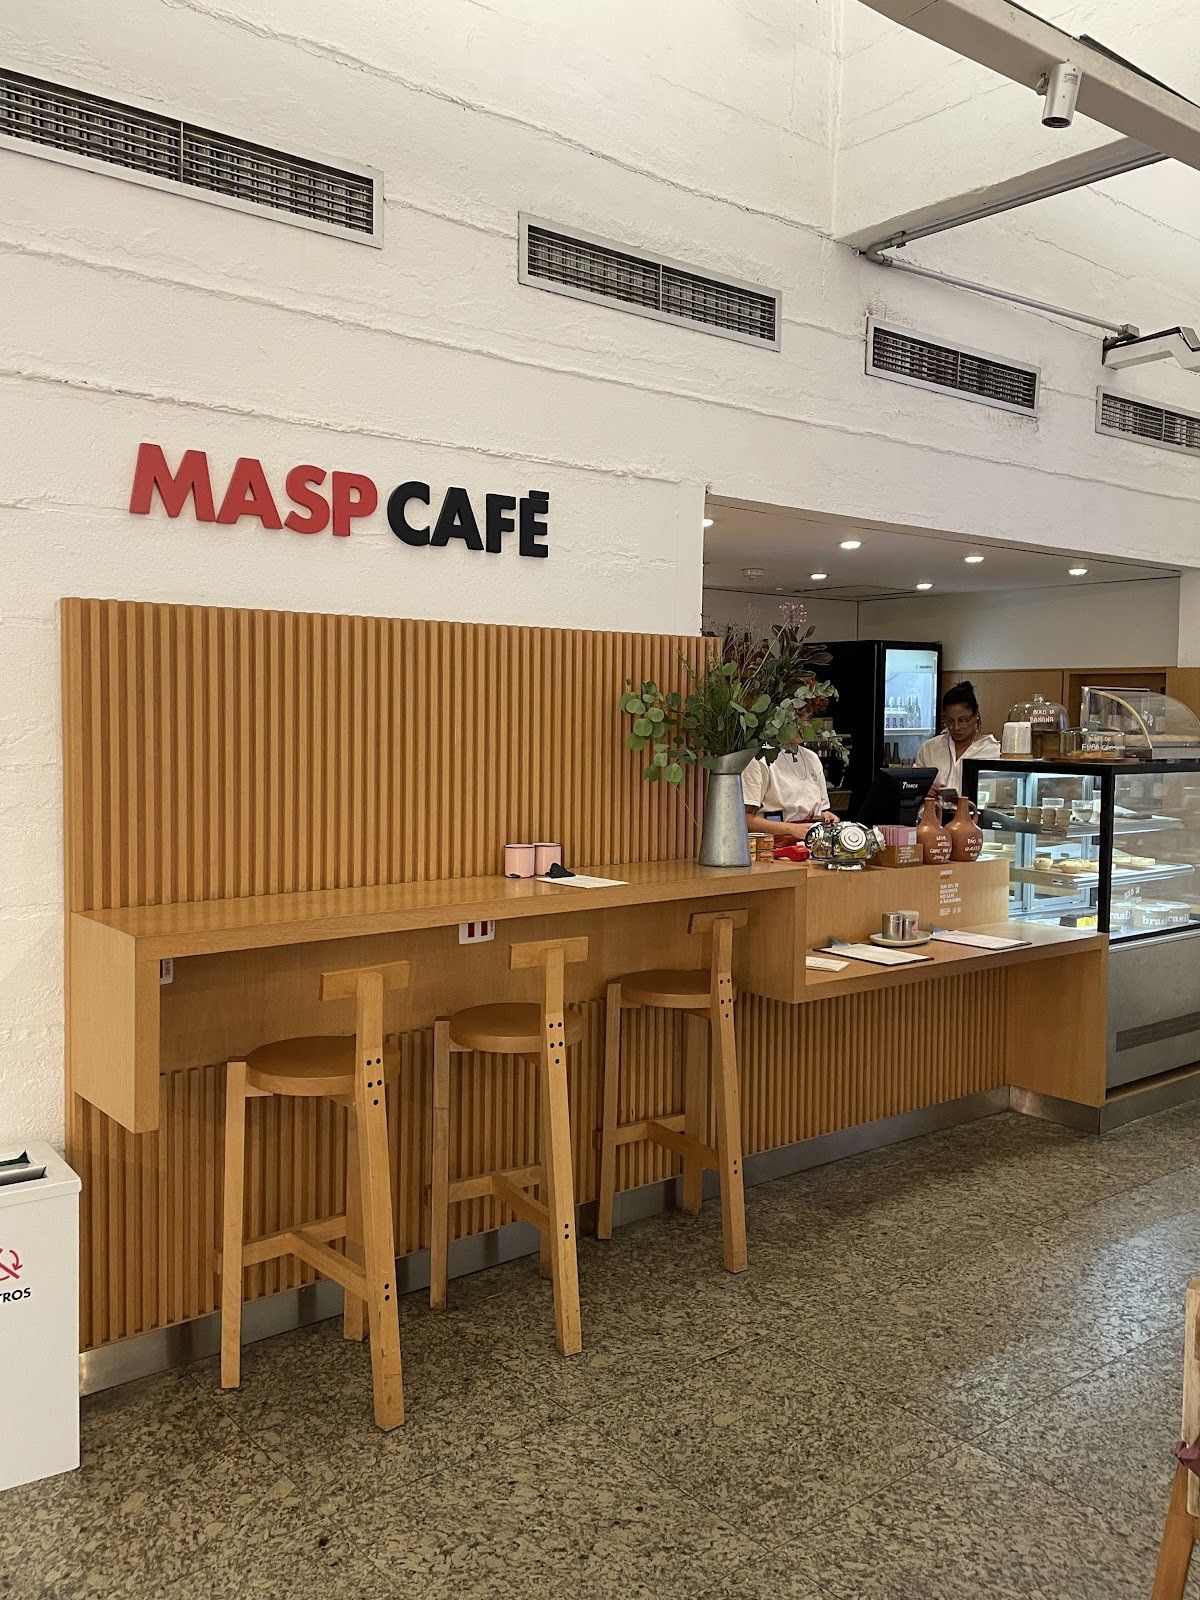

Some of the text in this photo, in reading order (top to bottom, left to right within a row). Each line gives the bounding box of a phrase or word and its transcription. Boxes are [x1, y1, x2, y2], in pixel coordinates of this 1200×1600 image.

[129, 442, 550, 558] MASP CAFÉ
[1029, 716, 1054, 724] BANANA
